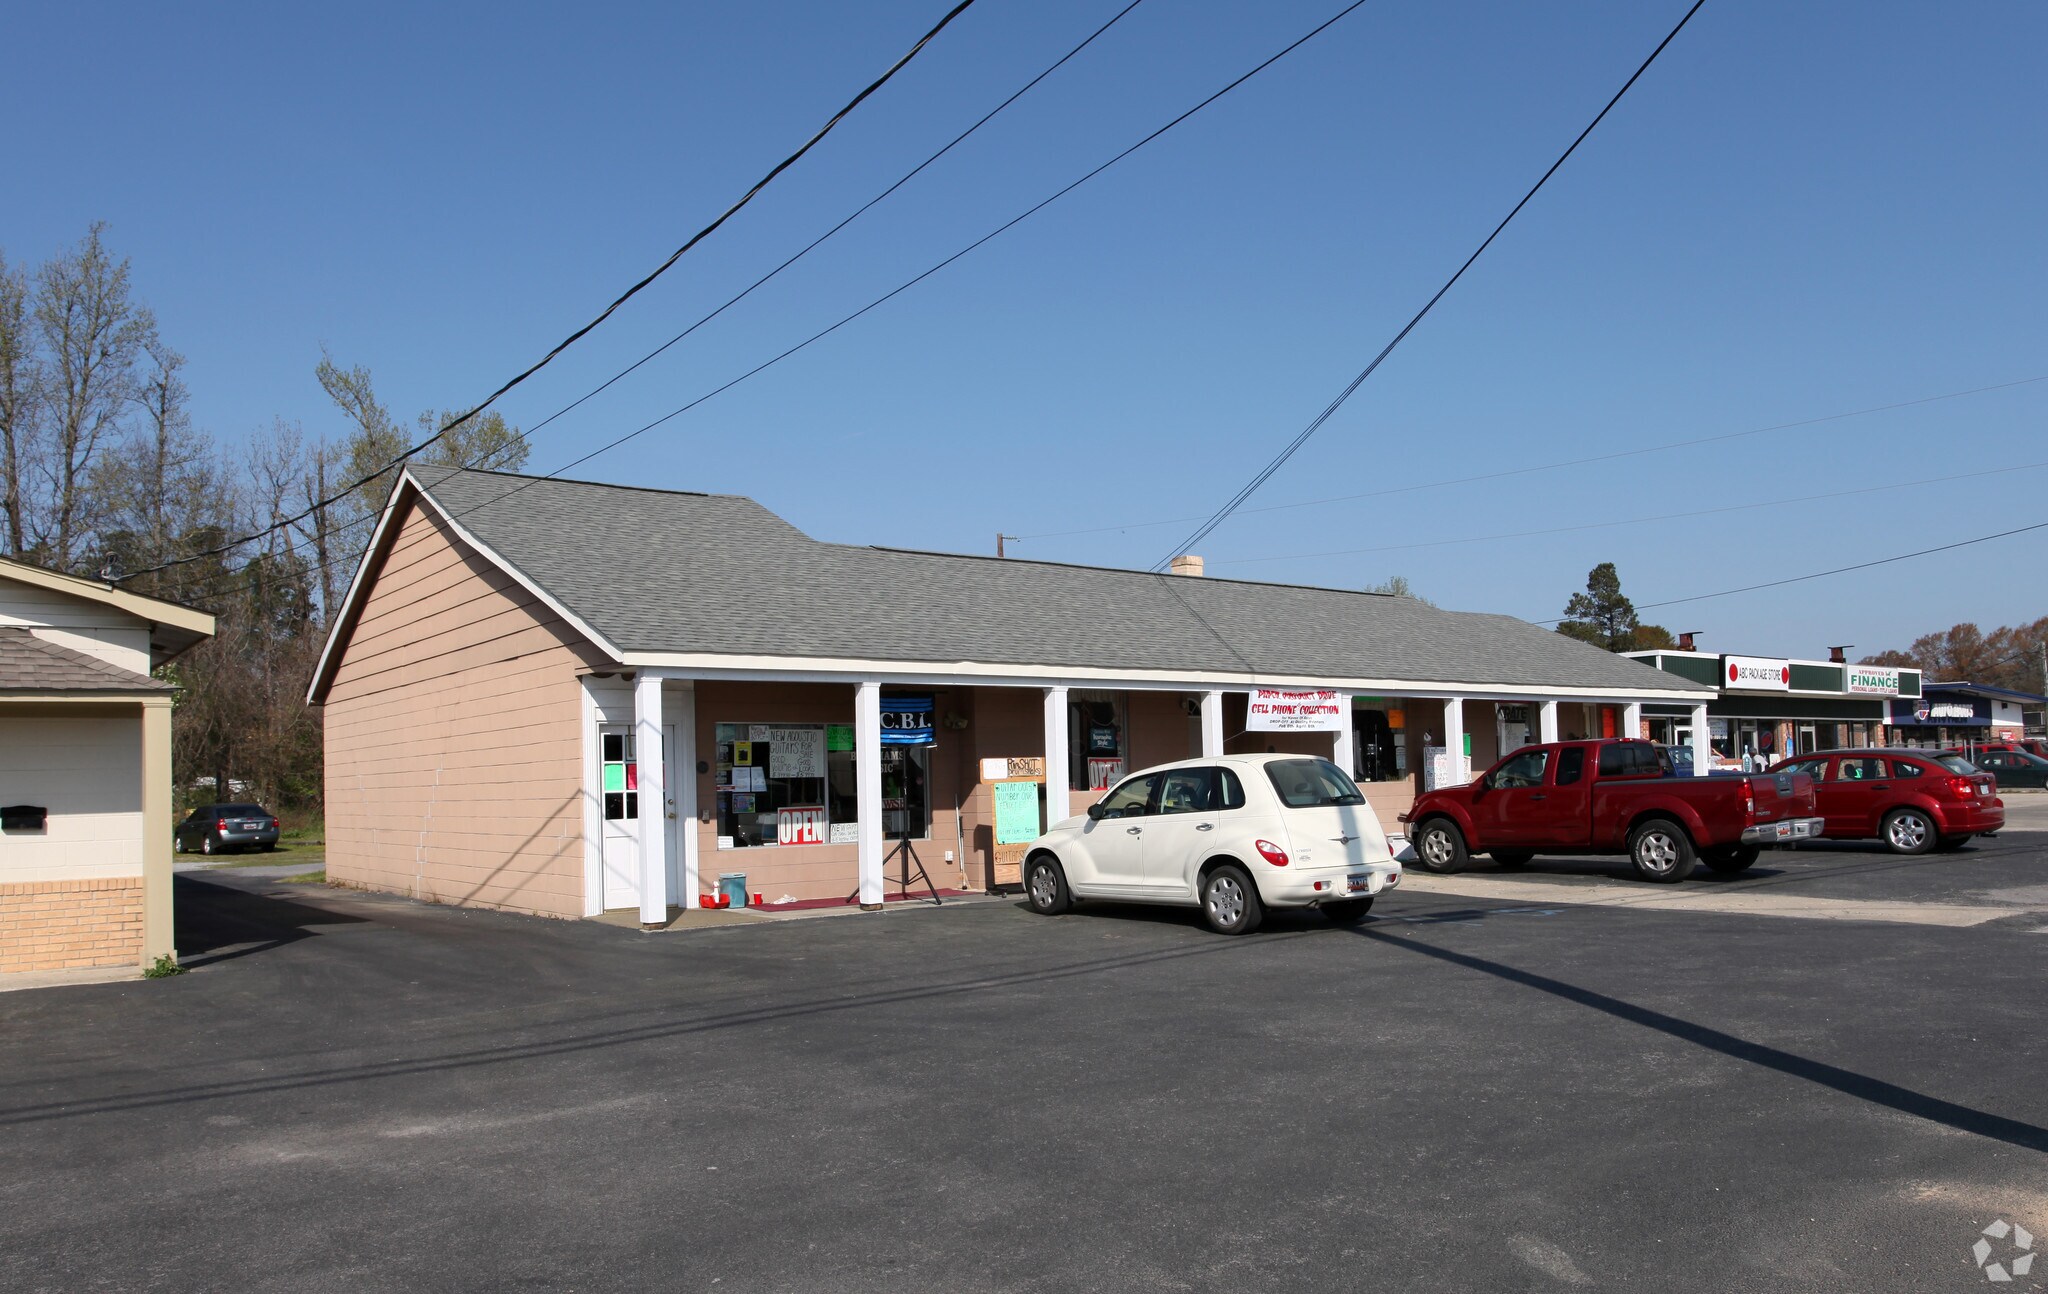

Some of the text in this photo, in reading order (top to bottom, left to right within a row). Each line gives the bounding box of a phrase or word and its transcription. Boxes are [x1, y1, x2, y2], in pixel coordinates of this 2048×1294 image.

[1739, 667, 1780, 680] ABC PACKAGE STORE
[1851, 675, 1898, 688] FINANCE
[1252, 704, 1339, 714] CELL PHONE COLLECTION
[771, 730, 786, 741] NEW
[801, 742, 813, 751] FOR
[781, 810, 824, 843] OPEN
